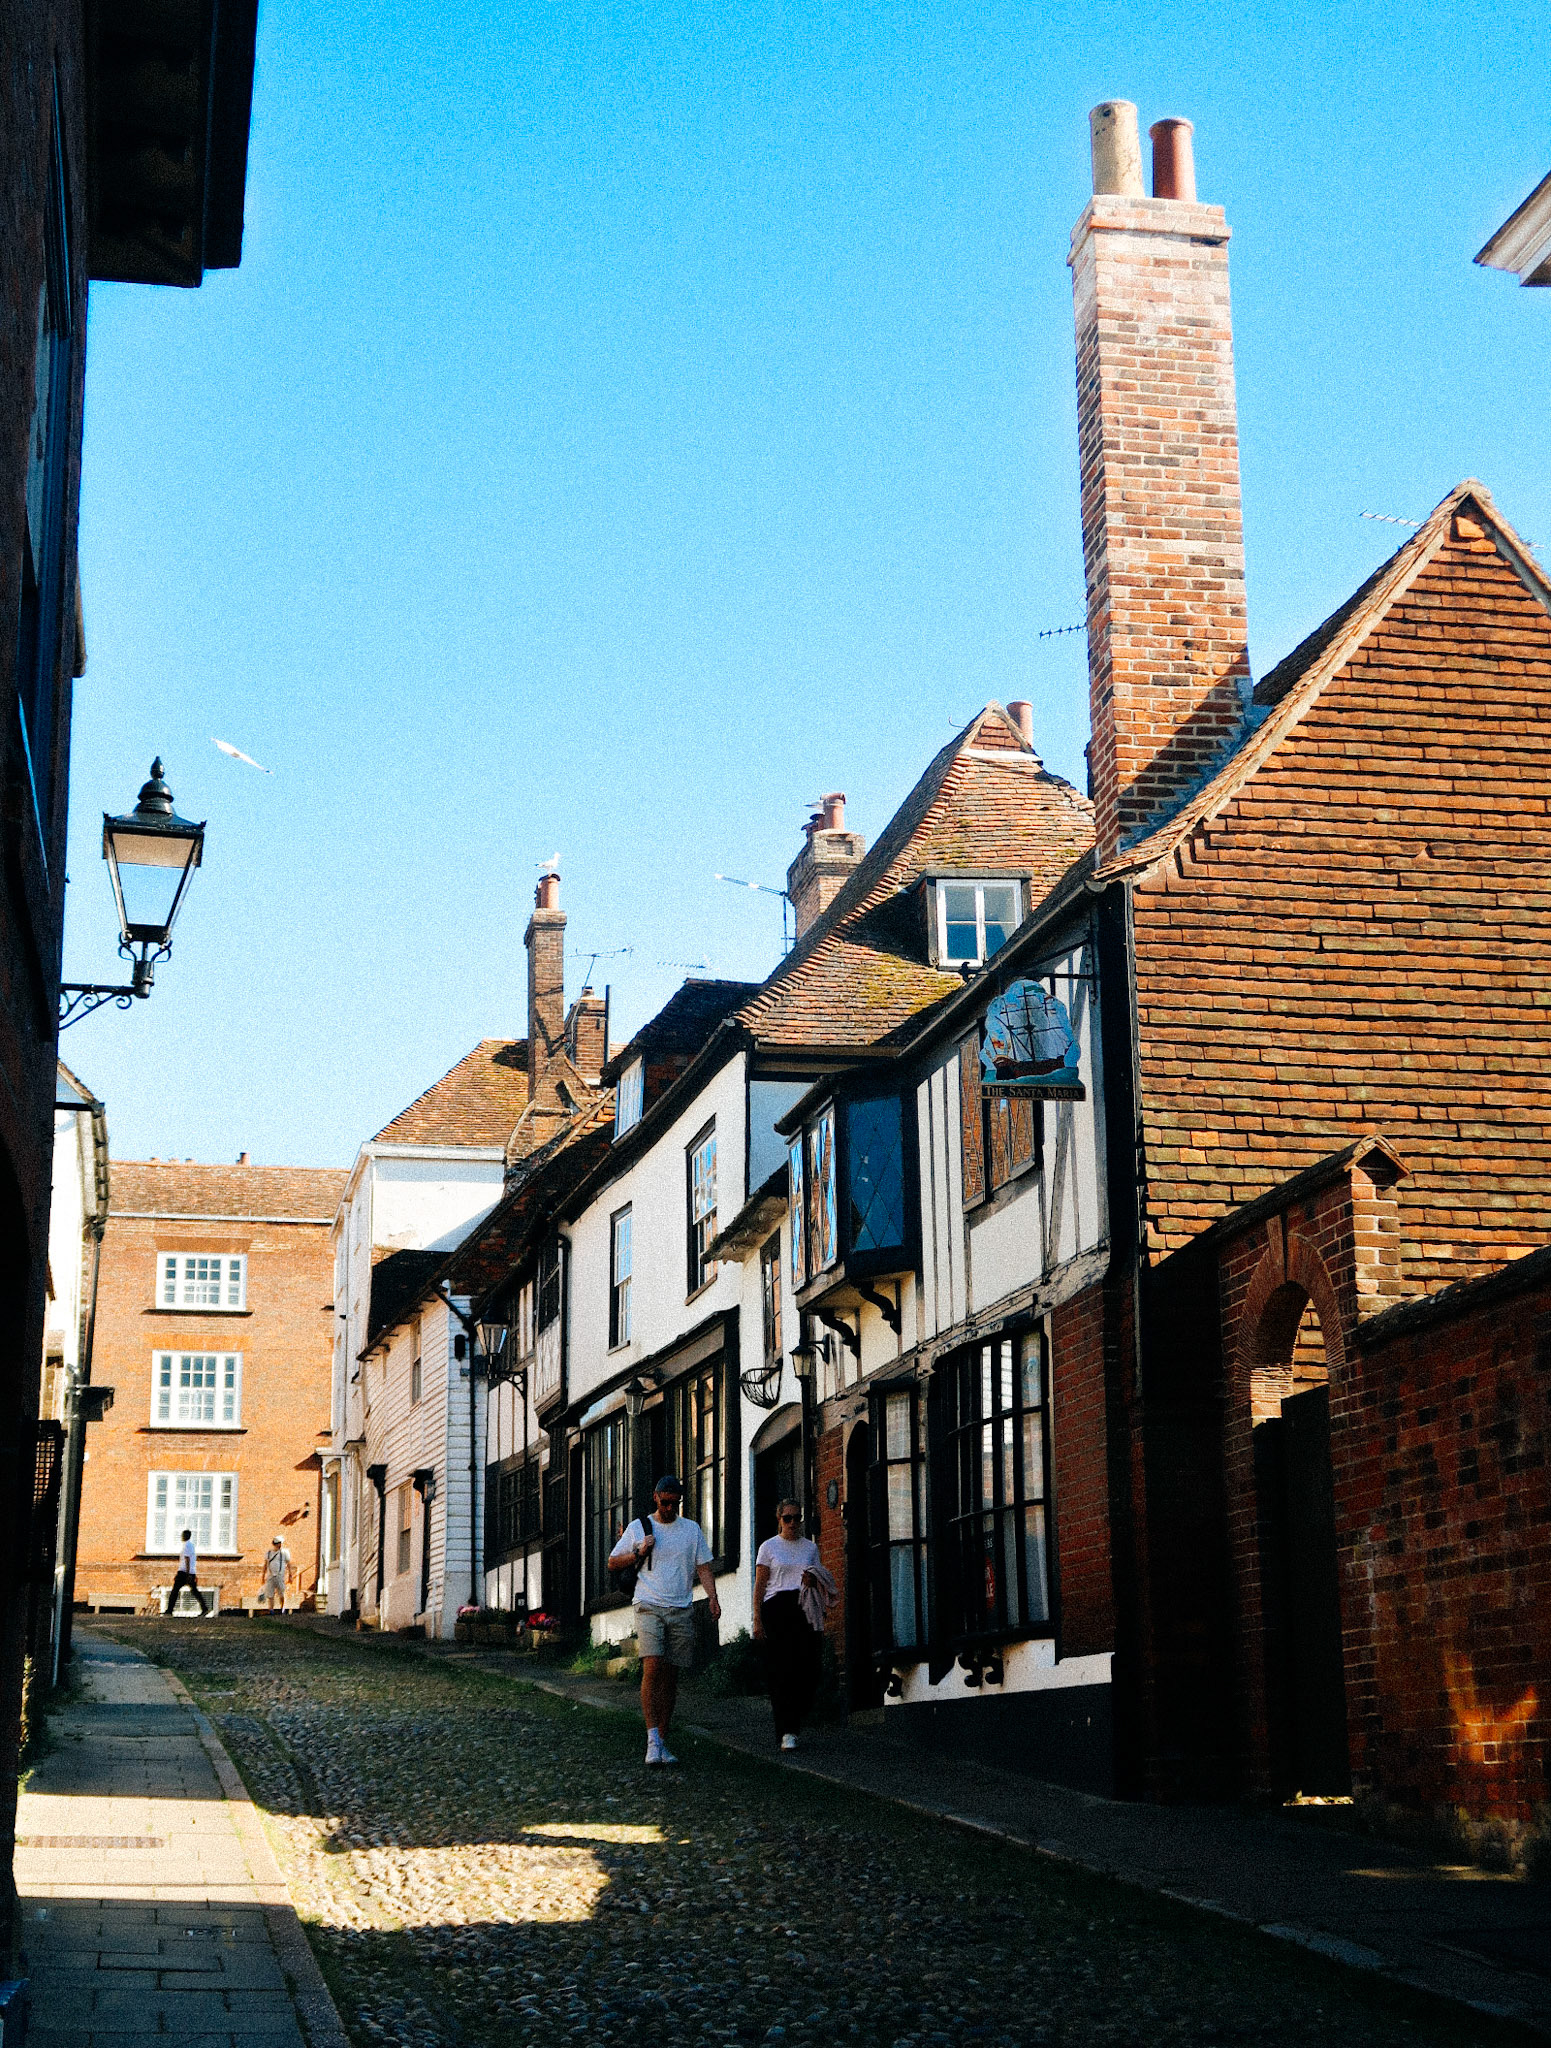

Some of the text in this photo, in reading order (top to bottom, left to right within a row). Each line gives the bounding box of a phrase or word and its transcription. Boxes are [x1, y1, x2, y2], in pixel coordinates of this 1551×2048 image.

[985, 1086, 1080, 1099] THE SANTA MARIA
